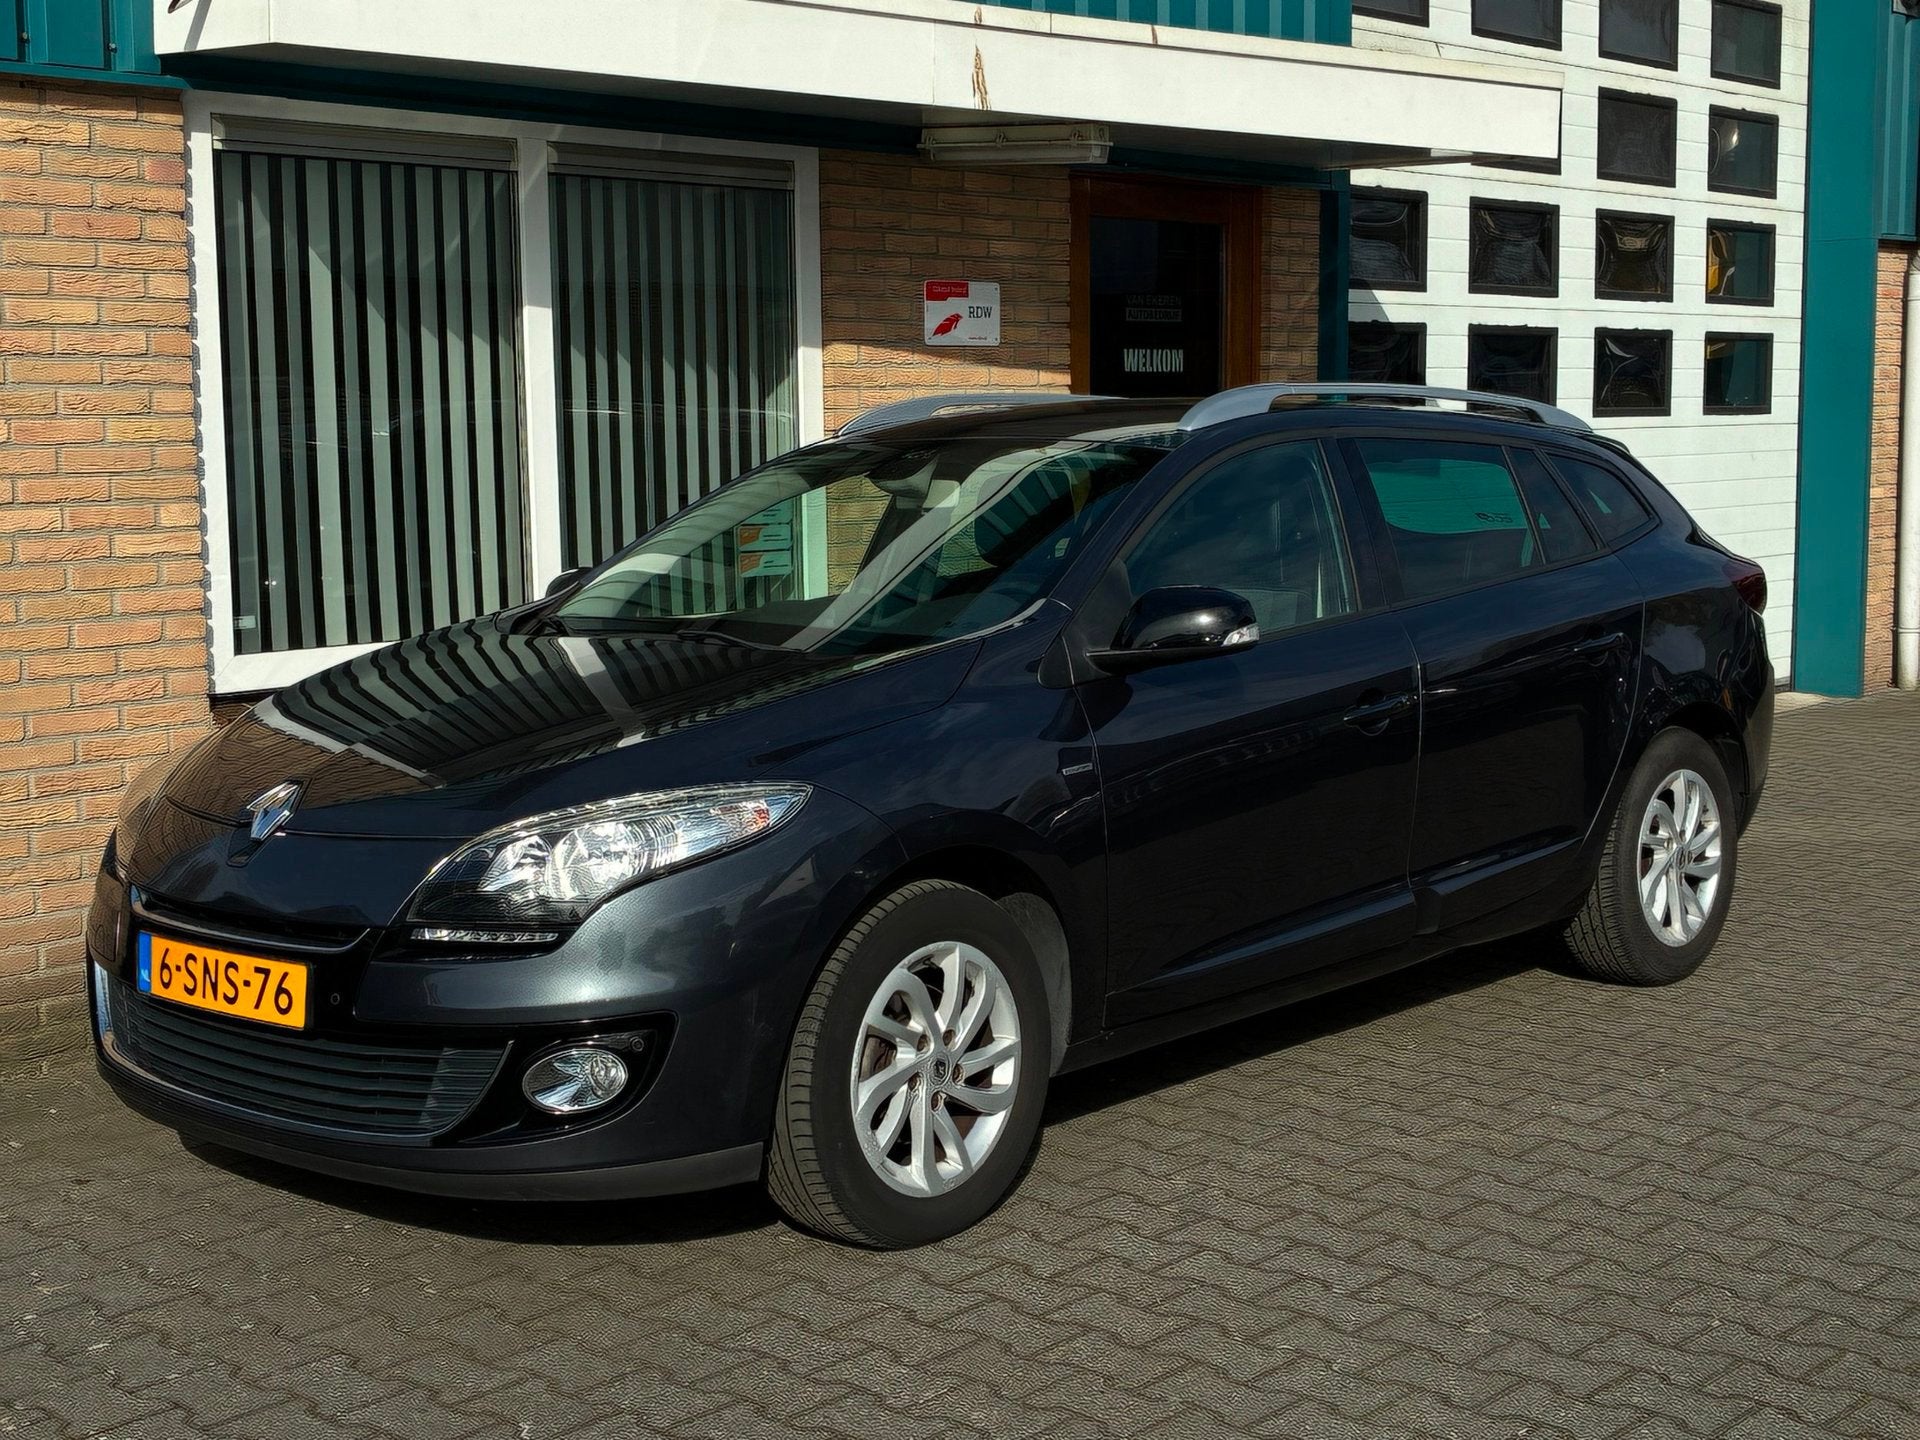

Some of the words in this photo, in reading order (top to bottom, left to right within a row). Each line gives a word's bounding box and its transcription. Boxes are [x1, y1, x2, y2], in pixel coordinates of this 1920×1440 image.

[968, 306, 993, 319] RDW
[1123, 348, 1184, 373] WELKOM
[159, 947, 293, 1016] 6-SNS-76
